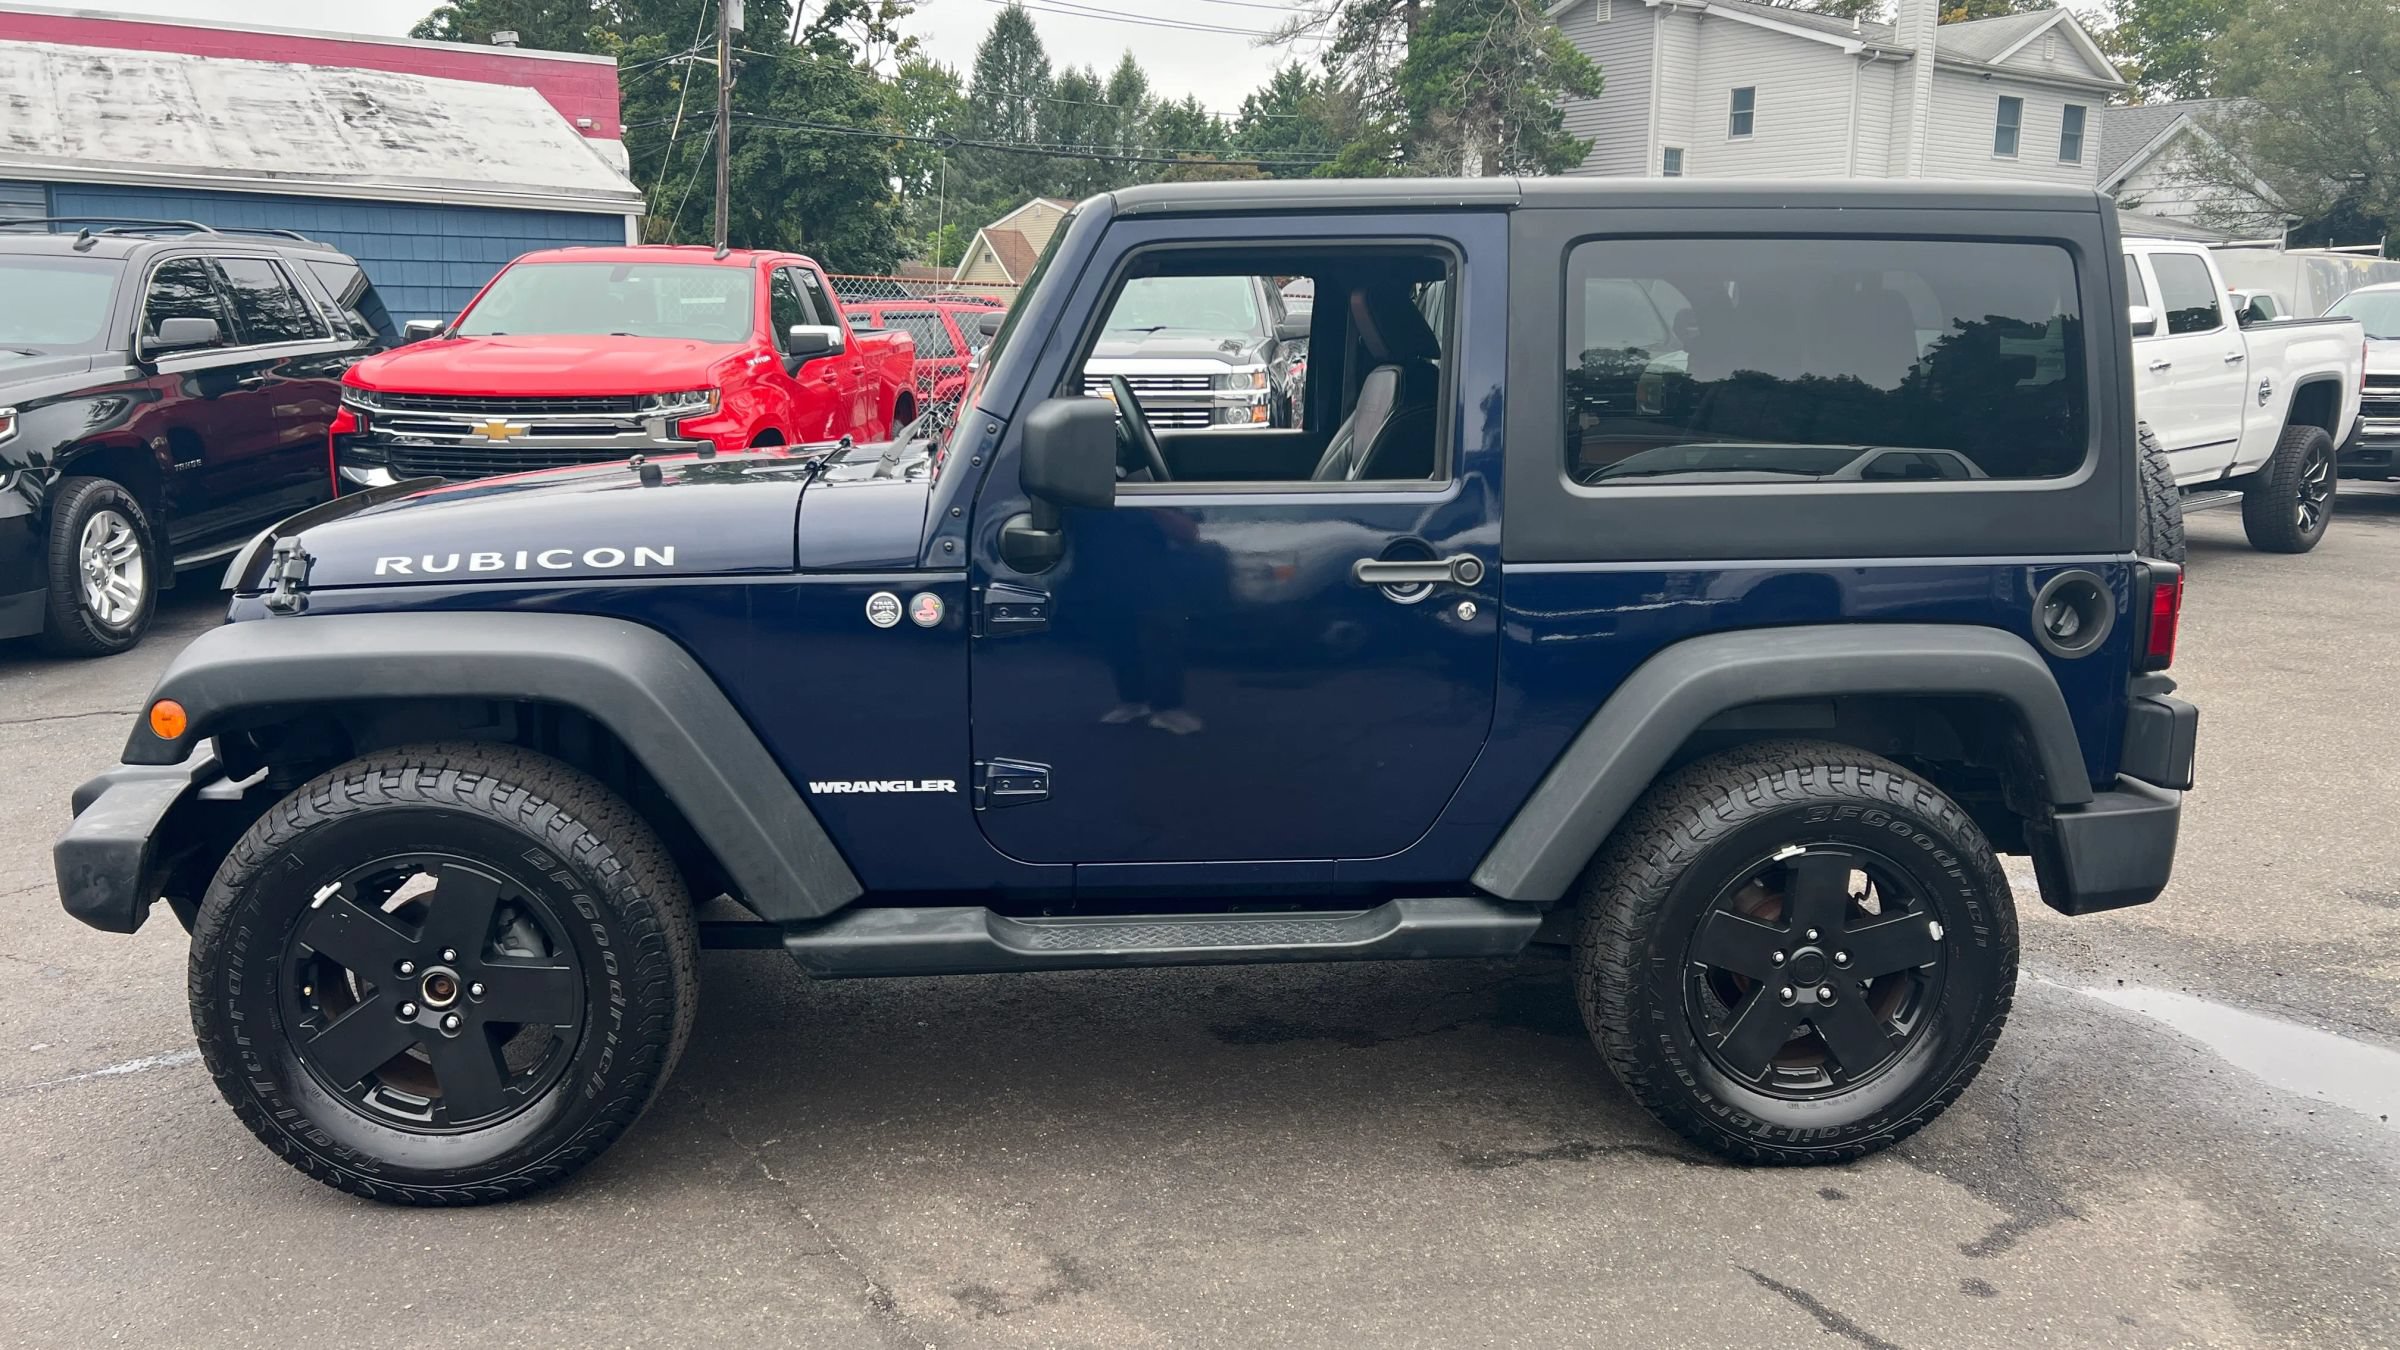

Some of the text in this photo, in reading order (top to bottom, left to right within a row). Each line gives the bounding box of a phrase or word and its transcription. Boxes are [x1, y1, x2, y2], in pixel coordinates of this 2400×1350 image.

[374, 546, 675, 576] RUBICON
[809, 780, 958, 794] WRANGLER
[1804, 805, 1990, 948] BFGoodrich
[521, 848, 626, 1099] BFGoodrich
